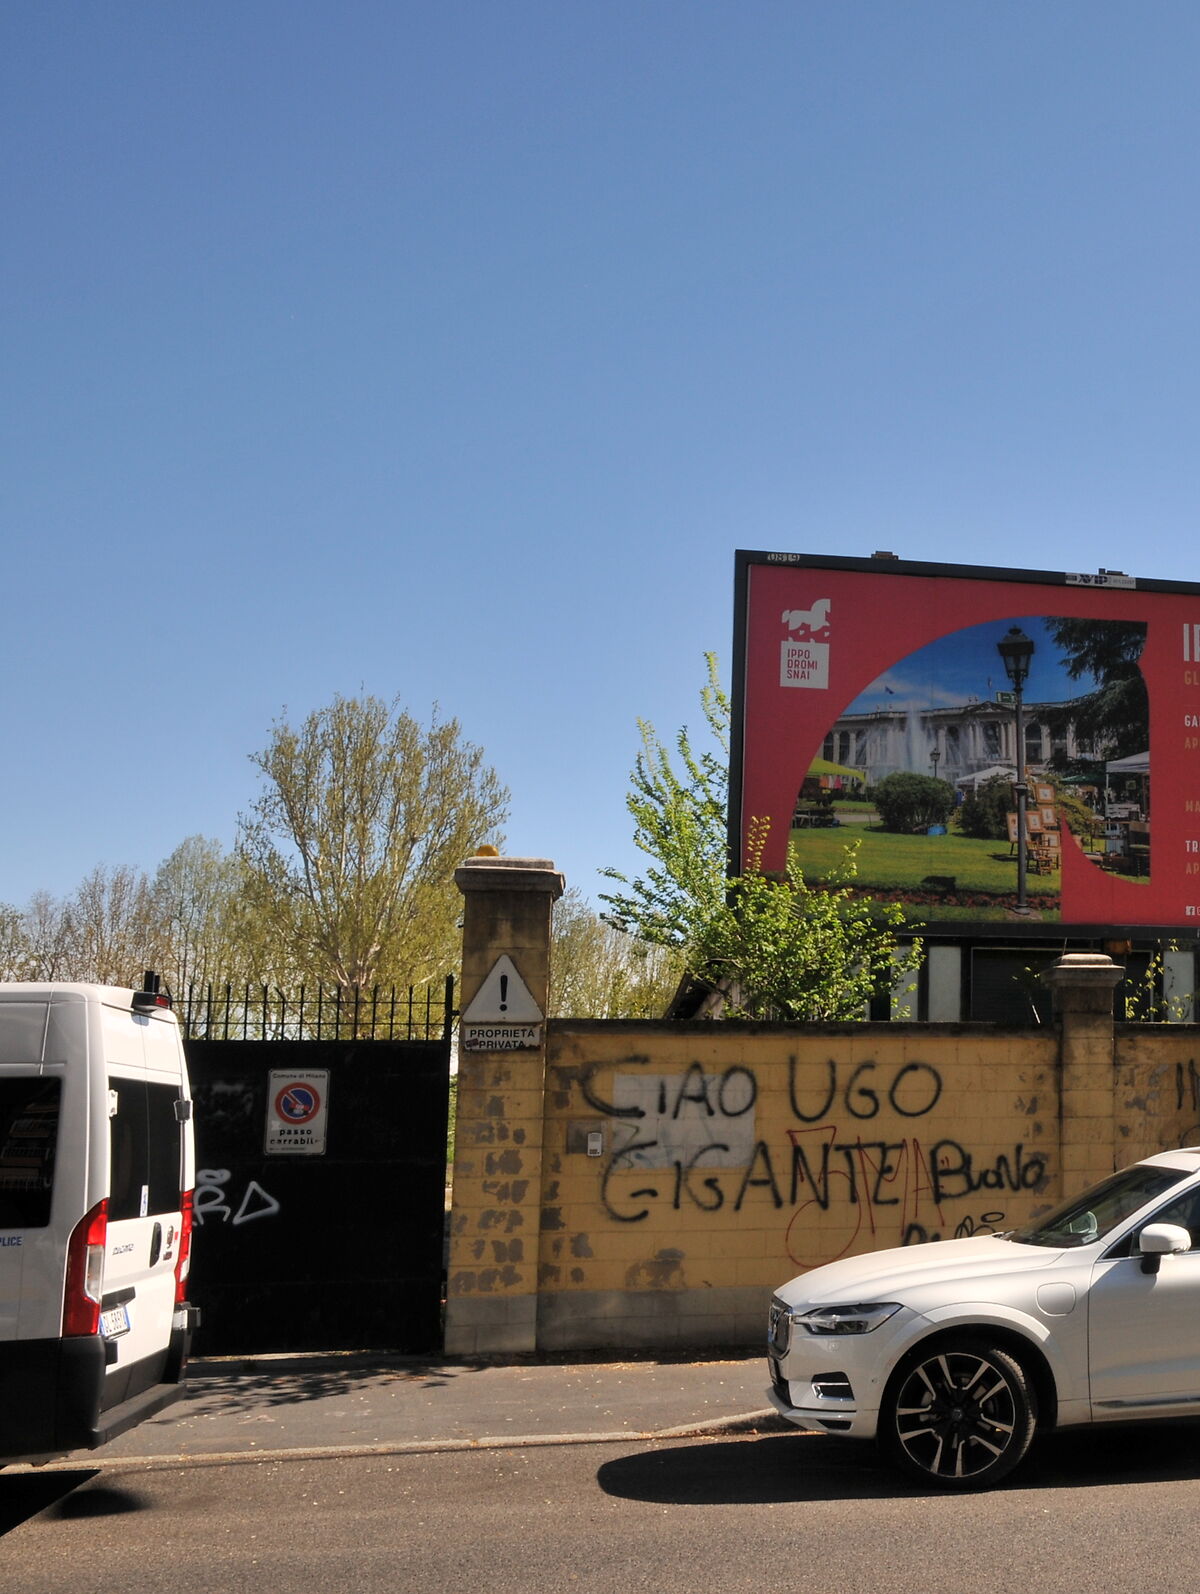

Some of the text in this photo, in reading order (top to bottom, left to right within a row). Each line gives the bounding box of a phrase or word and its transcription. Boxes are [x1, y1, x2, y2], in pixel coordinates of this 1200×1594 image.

[787, 648, 811, 659] IPPO
[787, 659, 818, 670] DROMI
[786, 669, 810, 680] SNAI
[478, 1040, 526, 1049] PRIVATA
[577, 1054, 942, 1123] CIAO UGO
[279, 1128, 312, 1137] passo
